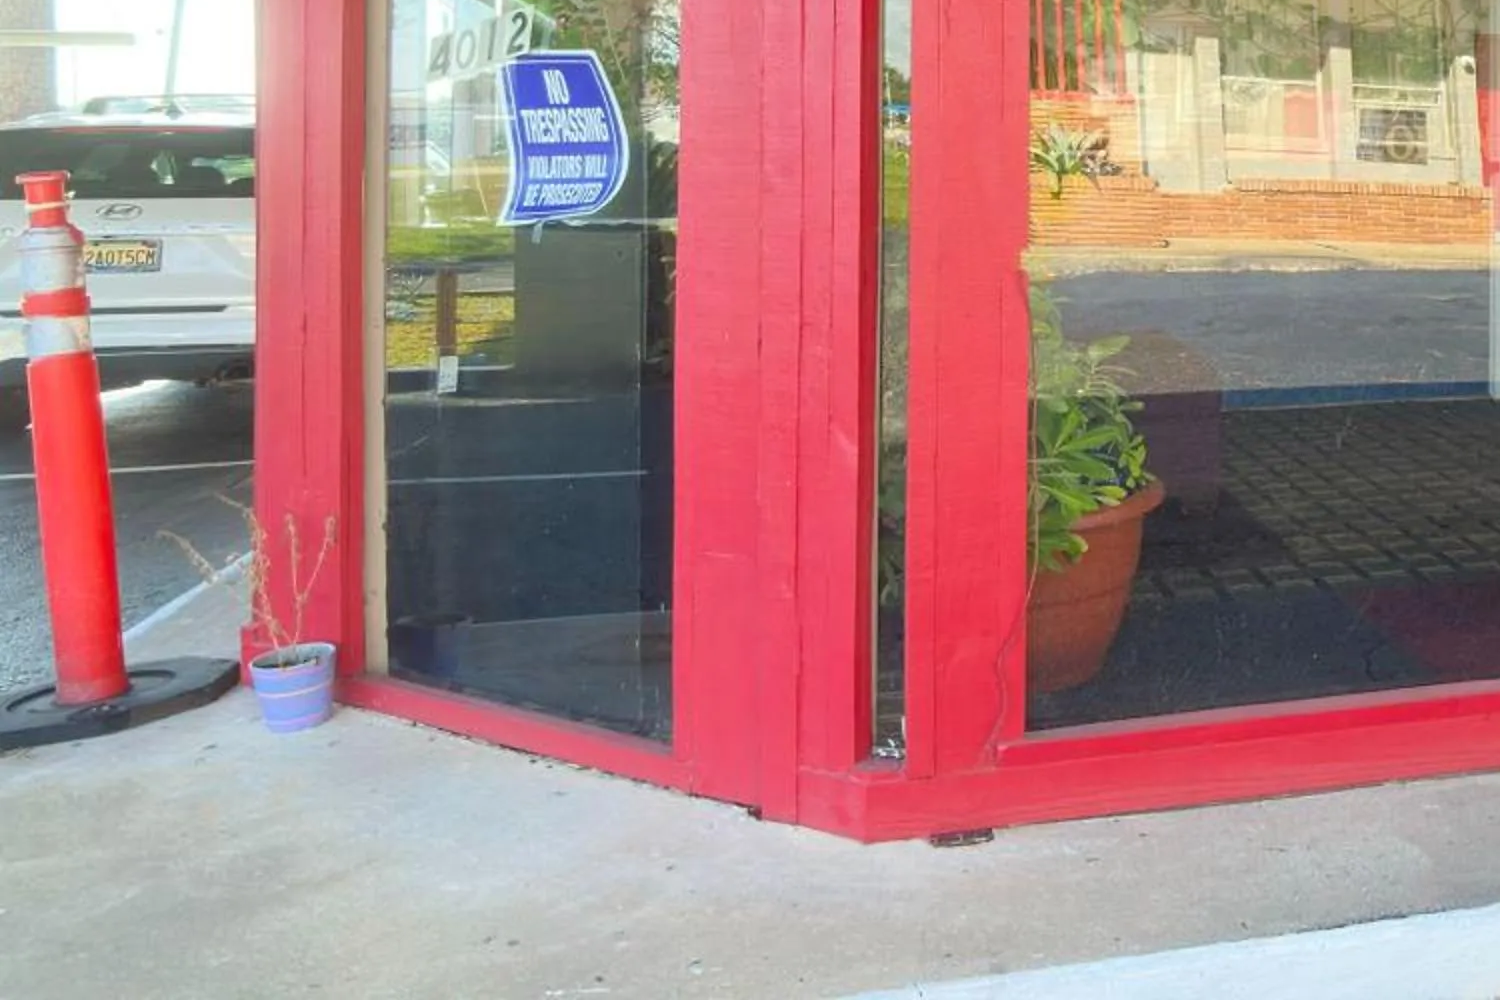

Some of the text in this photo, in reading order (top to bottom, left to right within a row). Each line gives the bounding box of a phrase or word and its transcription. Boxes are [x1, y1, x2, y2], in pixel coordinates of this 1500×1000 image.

[429, 10, 529, 75] 4012
[541, 69, 571, 104] NO
[520, 107, 609, 143] TRESPASSING
[528, 153, 608, 179] VIOLATORS WILL
[523, 183, 539, 207] BE
